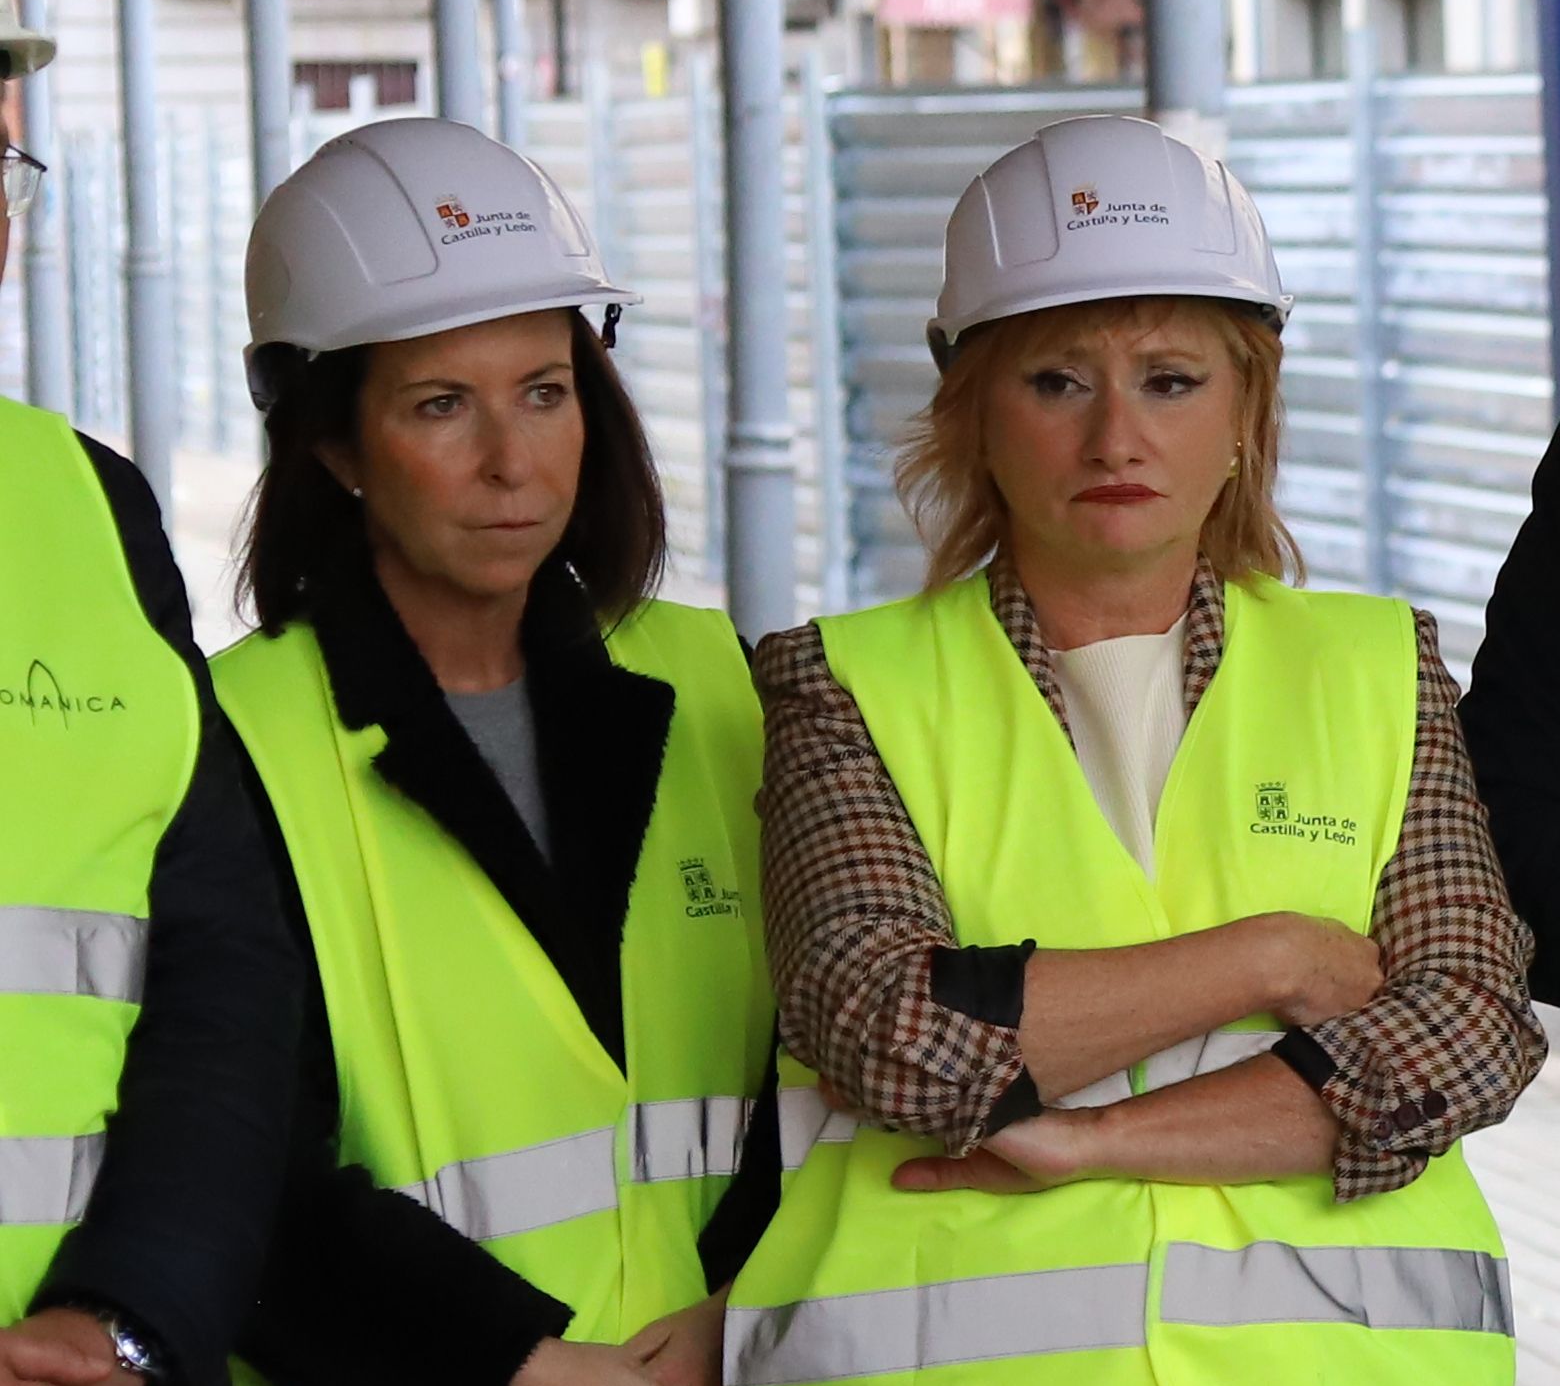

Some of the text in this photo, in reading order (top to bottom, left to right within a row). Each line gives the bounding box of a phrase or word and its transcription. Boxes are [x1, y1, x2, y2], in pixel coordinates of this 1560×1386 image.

[1105, 203, 1167, 213] Junta de
[475, 211, 532, 224] Junta de
[1067, 214, 1169, 231] Castilla y León
[441, 223, 537, 245] Castilla y León
[1294, 813, 1357, 831] Junta de
[1250, 823, 1356, 846] Castilla y León
[686, 904, 732, 918] Castilla
